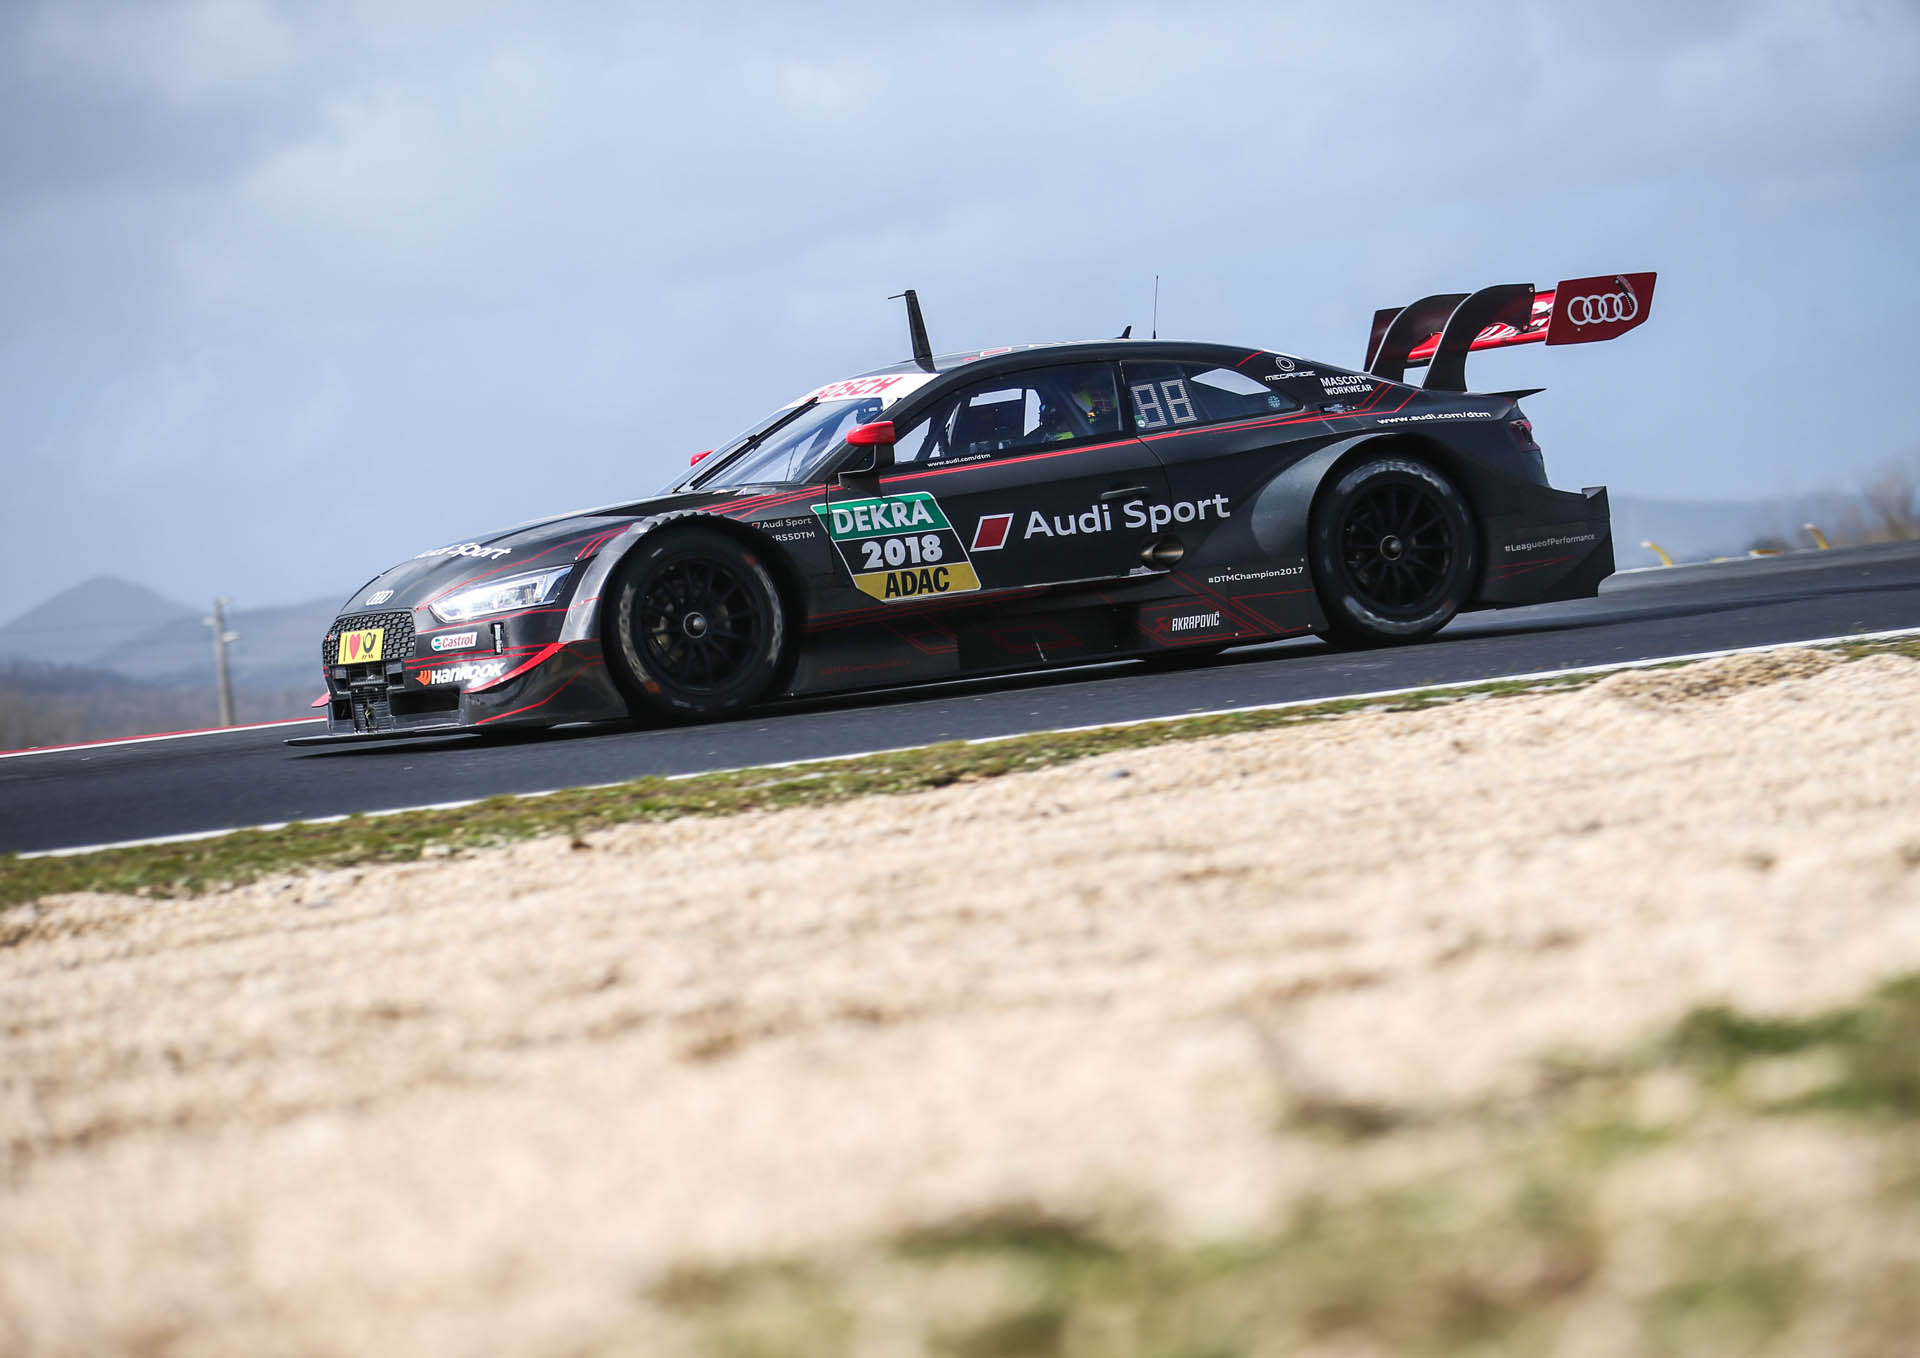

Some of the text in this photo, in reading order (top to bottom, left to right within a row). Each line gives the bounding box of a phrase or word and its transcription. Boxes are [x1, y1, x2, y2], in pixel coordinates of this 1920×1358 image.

[1324, 384, 1373, 396] WORKWEAR
[1376, 411, 1492, 425] www.audi.com/dtm
[927, 453, 991, 468] www.audi.com/dtm
[762, 517, 812, 529] Audi Sport
[831, 499, 934, 534] DEKRA
[1023, 493, 1231, 539] Audi Sport
[1504, 533, 1595, 552] #LeagueofPerformance
[861, 534, 943, 570] 2018
[885, 567, 950, 598] ADAC
[1208, 566, 1304, 583] #DTMChampion2017
[442, 634, 474, 648] Castrol
